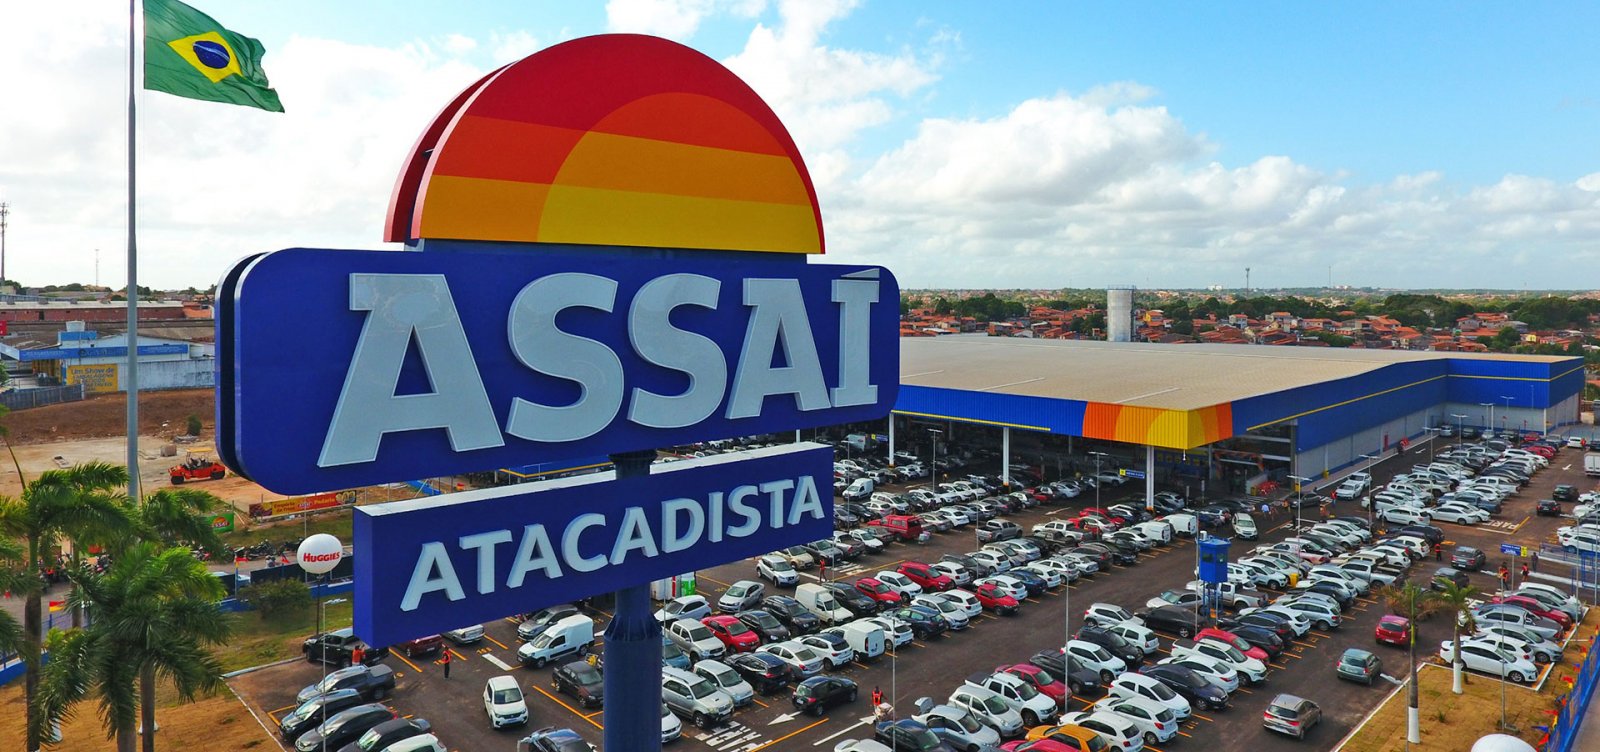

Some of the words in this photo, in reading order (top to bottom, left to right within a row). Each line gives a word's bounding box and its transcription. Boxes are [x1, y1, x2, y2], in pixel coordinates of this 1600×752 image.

[316, 267, 880, 468] ASSAÍ
[303, 552, 340, 562] HUGGIES
[400, 474, 826, 612] ATACADISTA
